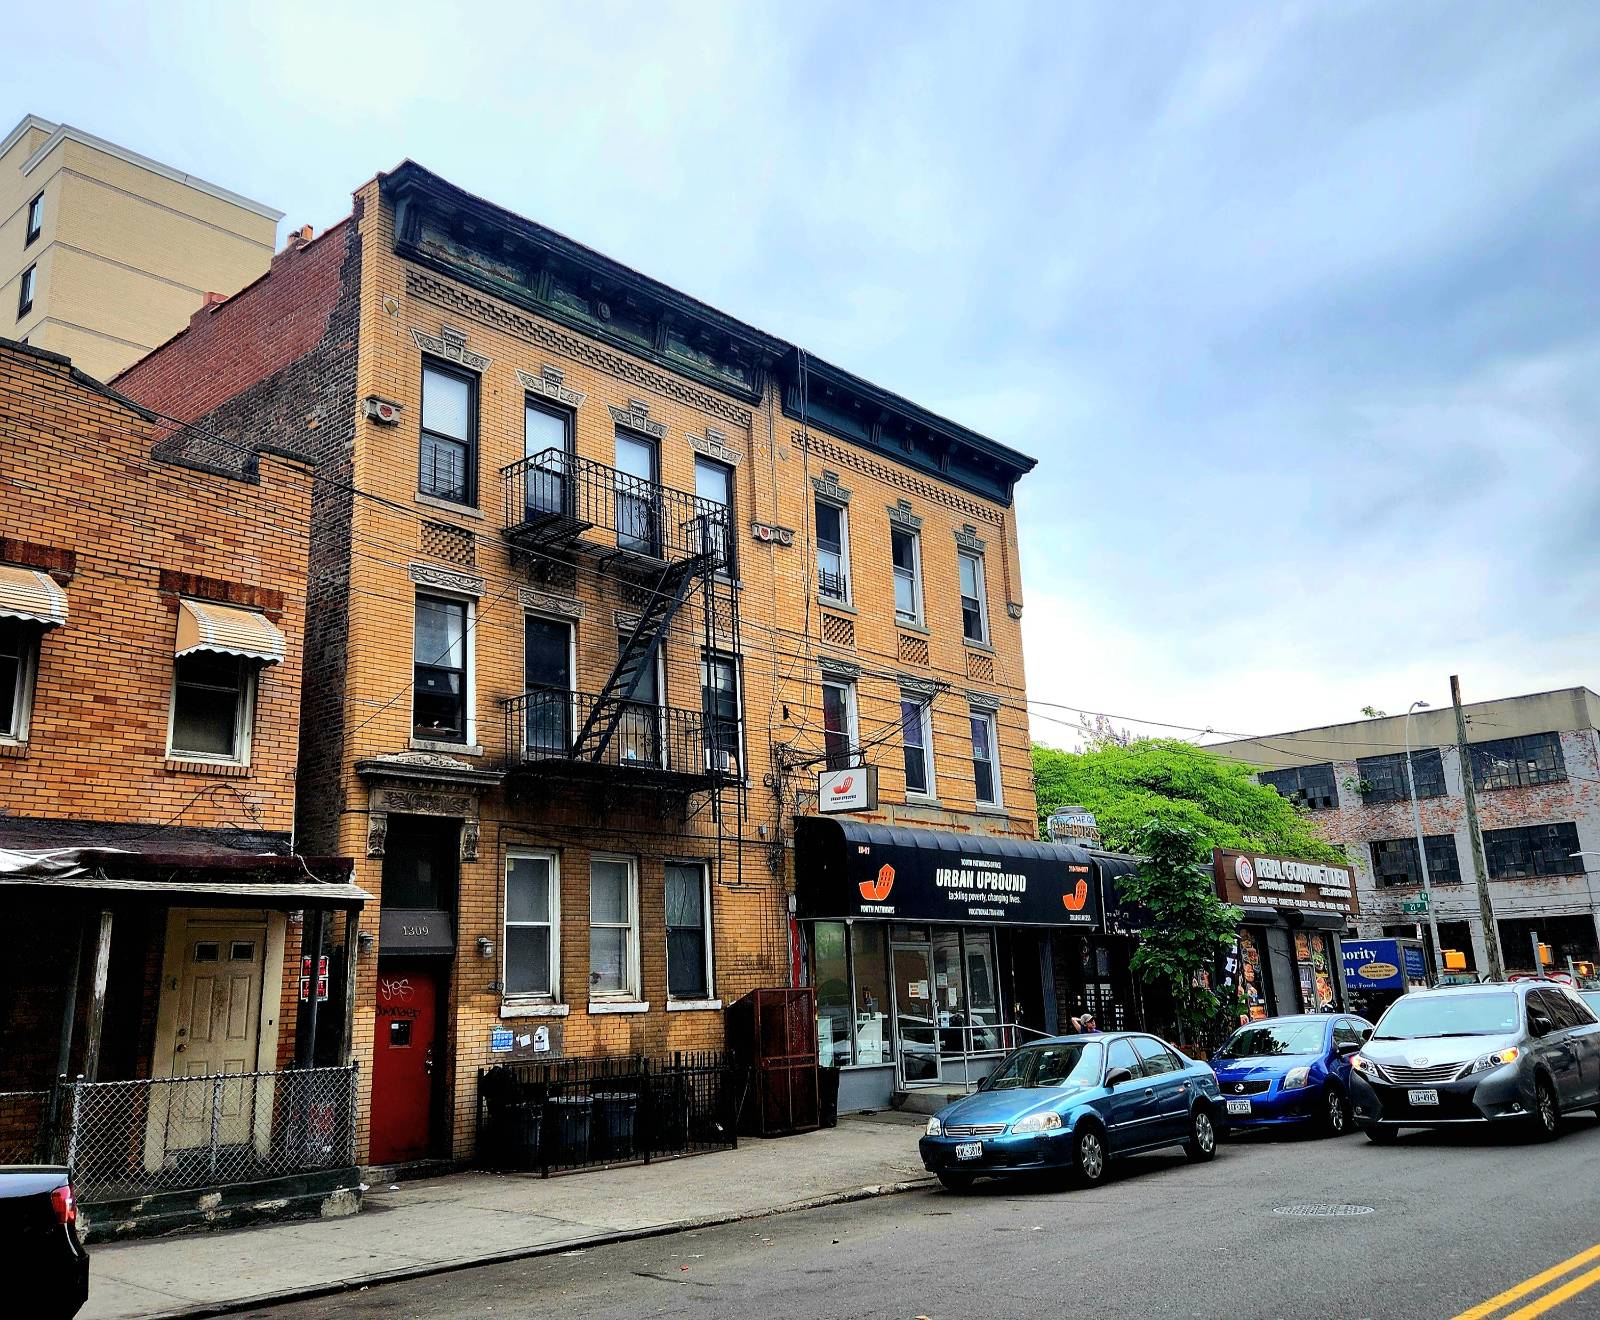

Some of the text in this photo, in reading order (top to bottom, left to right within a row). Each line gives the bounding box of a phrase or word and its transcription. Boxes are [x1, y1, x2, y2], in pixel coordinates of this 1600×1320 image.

[1254, 858, 1286, 880] REAL
[936, 868, 1026, 893] URBAN UPBOUND
[402, 925, 429, 936] 1309
